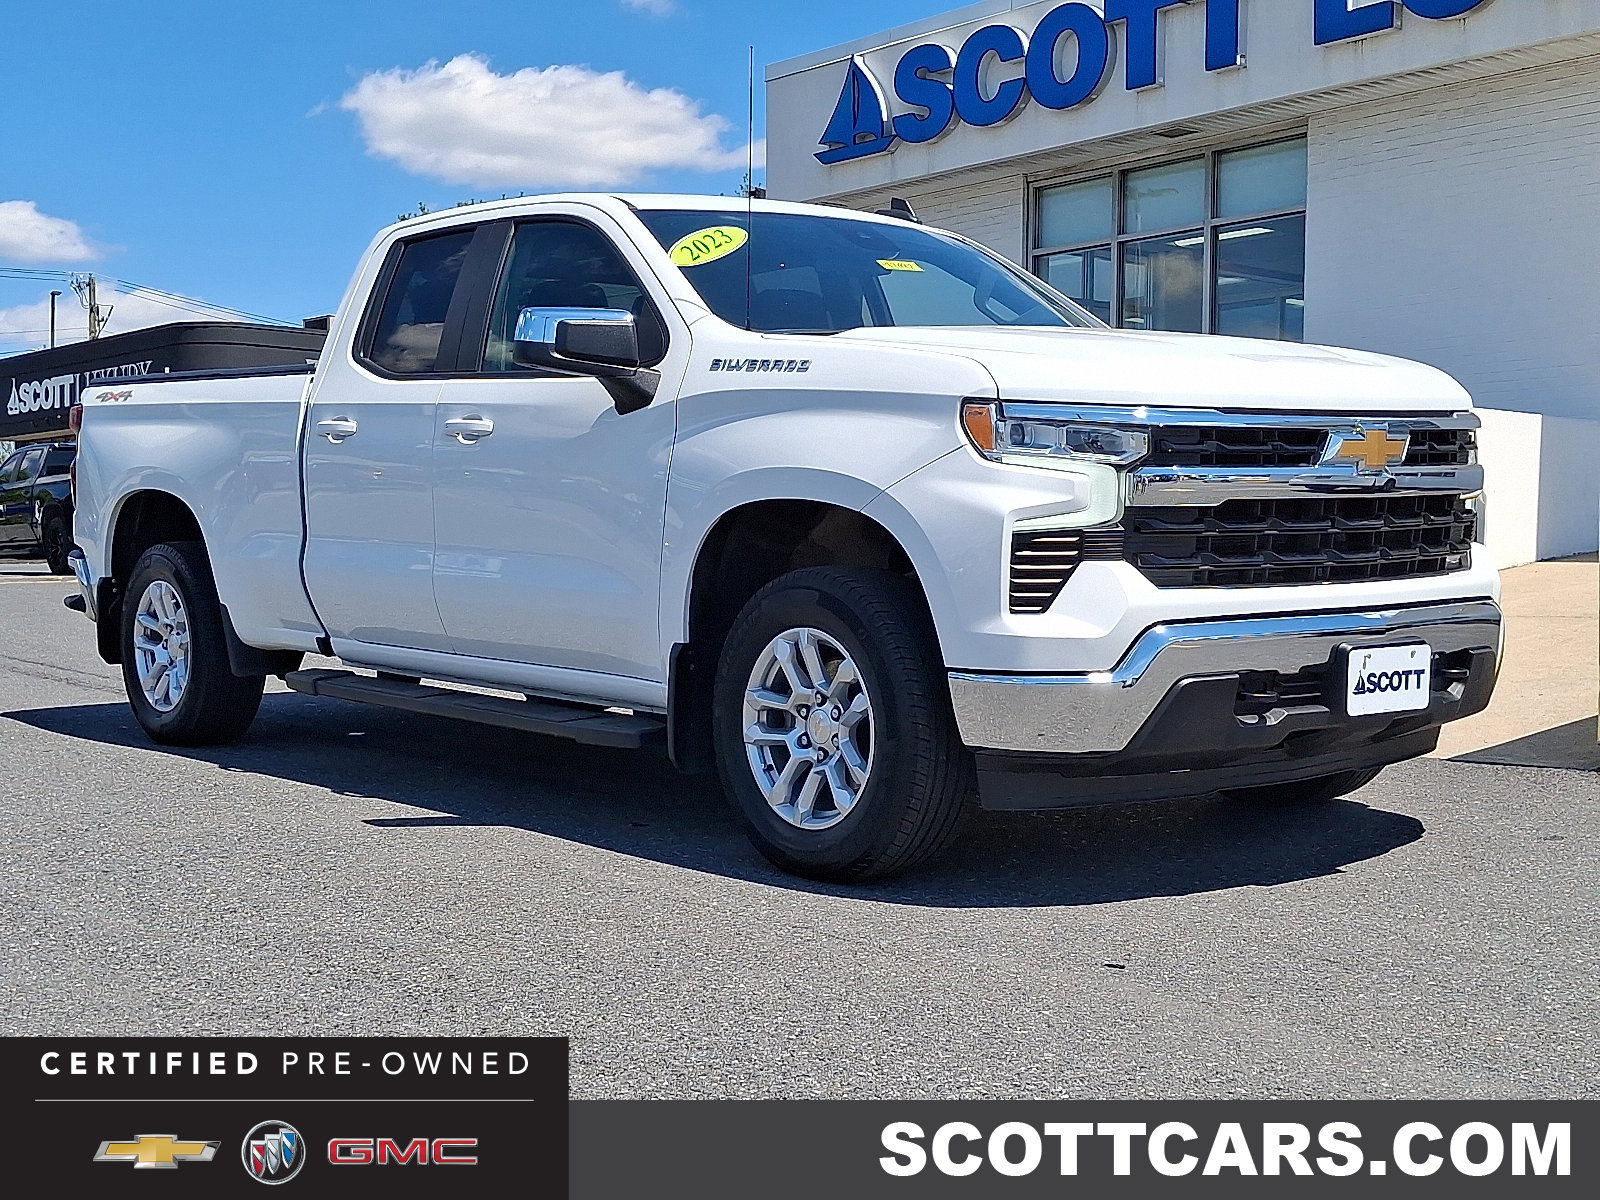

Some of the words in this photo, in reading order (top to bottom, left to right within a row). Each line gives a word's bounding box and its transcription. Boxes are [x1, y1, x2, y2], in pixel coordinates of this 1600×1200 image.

[681, 229, 733, 261] 2023
[709, 358, 812, 373] SILVERADO
[19, 374, 74, 413] SCOTT
[1366, 669, 1425, 693] SCOTT
